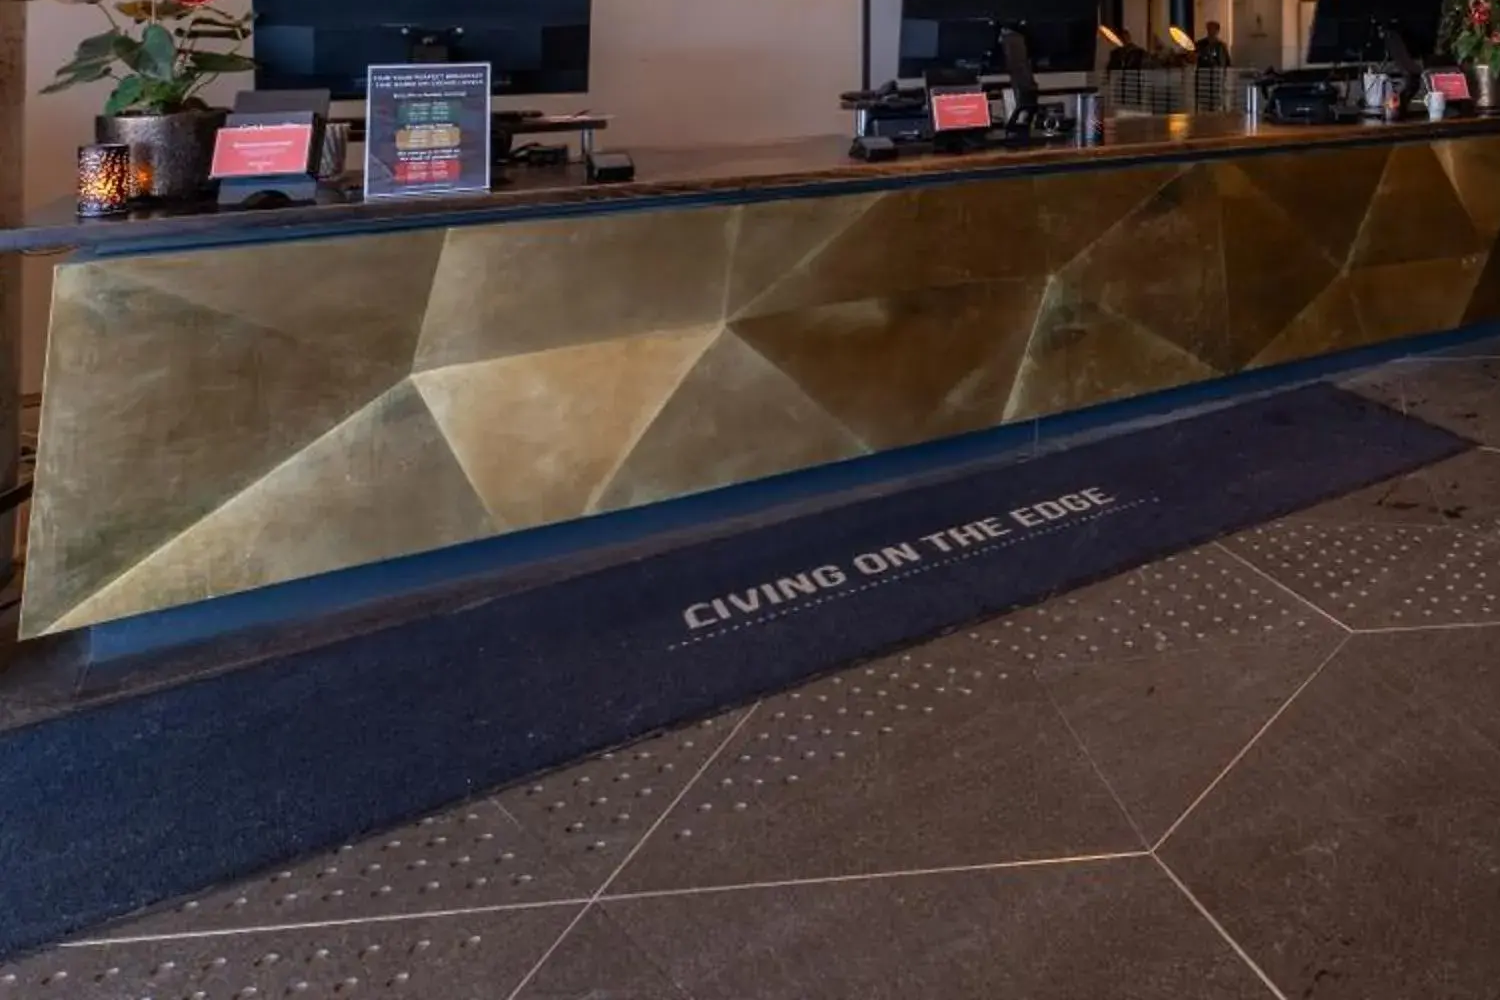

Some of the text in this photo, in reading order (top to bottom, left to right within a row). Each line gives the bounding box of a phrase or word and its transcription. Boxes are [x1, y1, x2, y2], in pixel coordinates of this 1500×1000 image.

[853, 541, 922, 576] ON
[919, 516, 1013, 555] THE
[1009, 486, 1117, 530] EDGE
